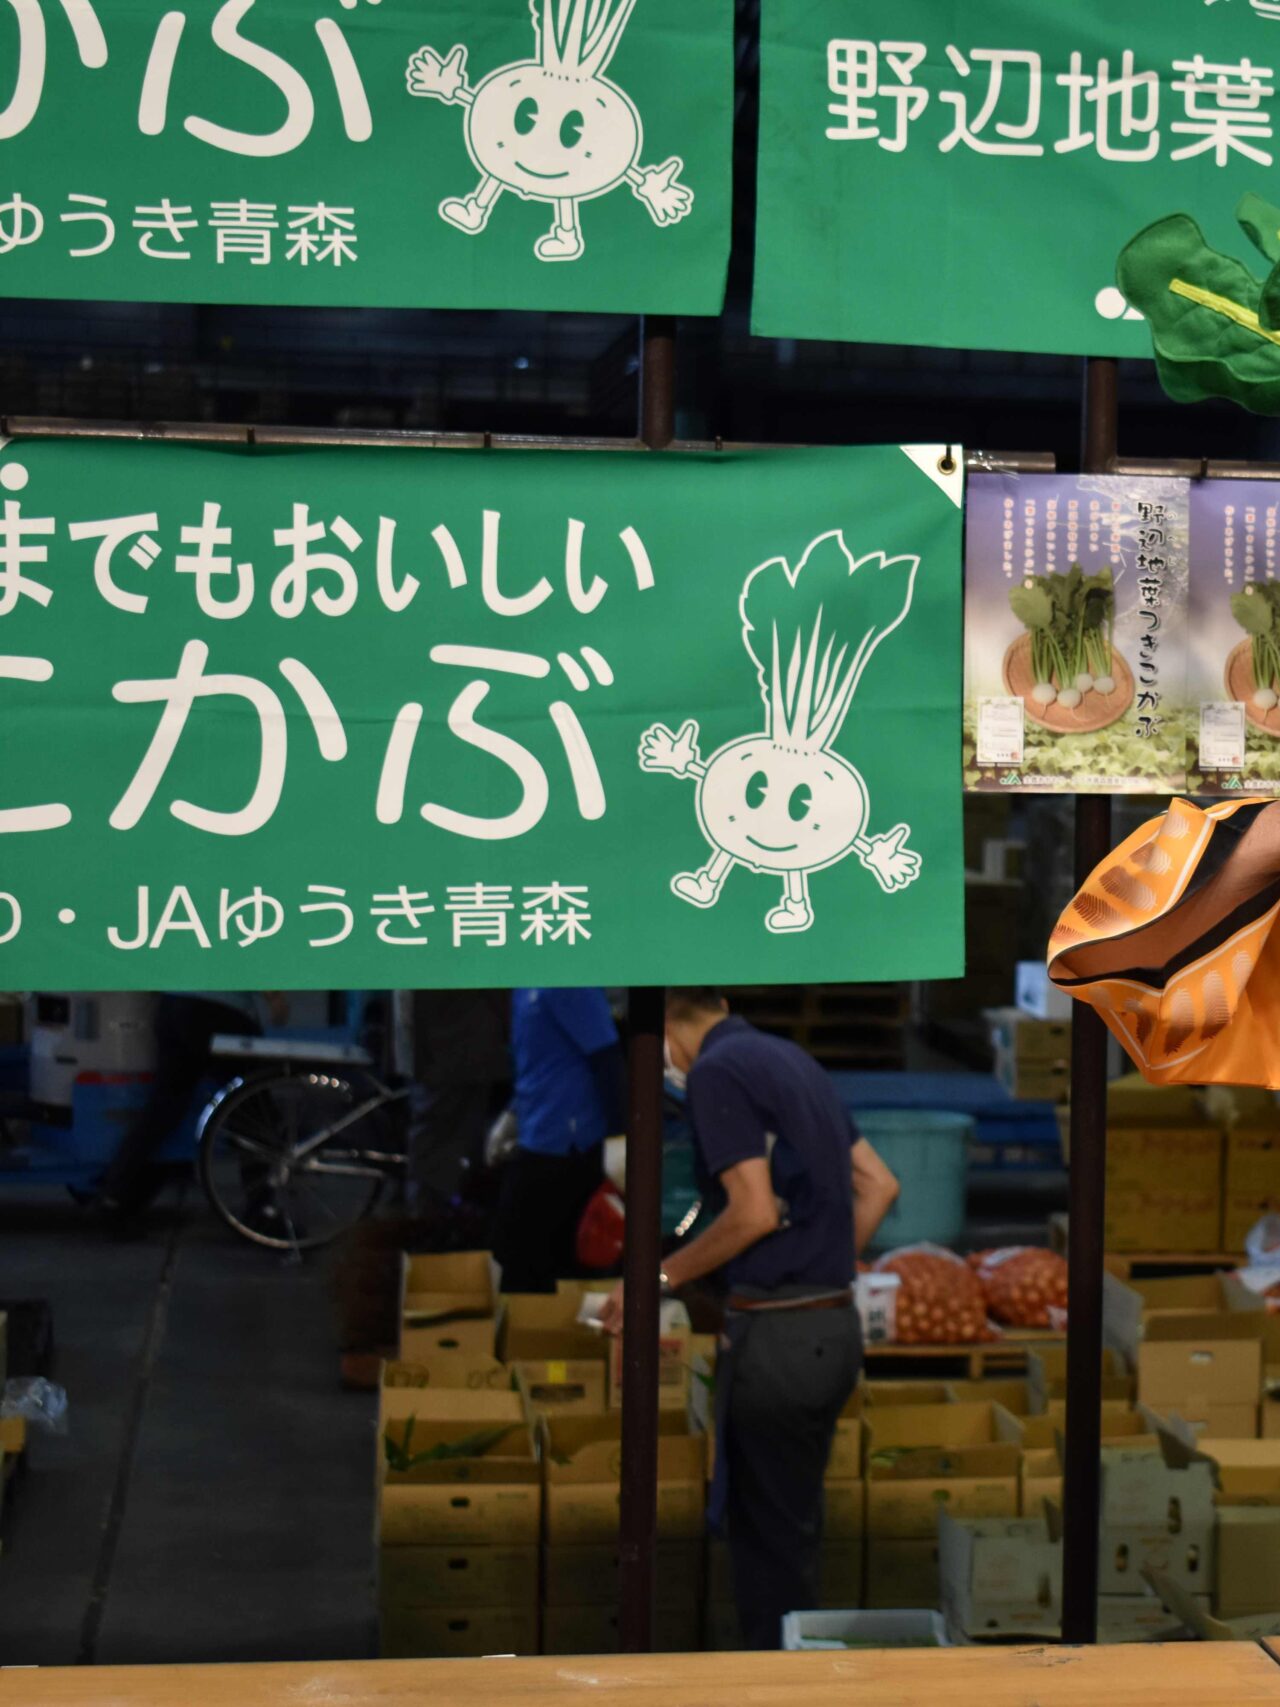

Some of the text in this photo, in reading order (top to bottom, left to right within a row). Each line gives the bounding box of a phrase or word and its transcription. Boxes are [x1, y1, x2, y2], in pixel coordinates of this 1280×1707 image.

[1136, 502, 1168, 738] 野辺地葉つきこかぶ
